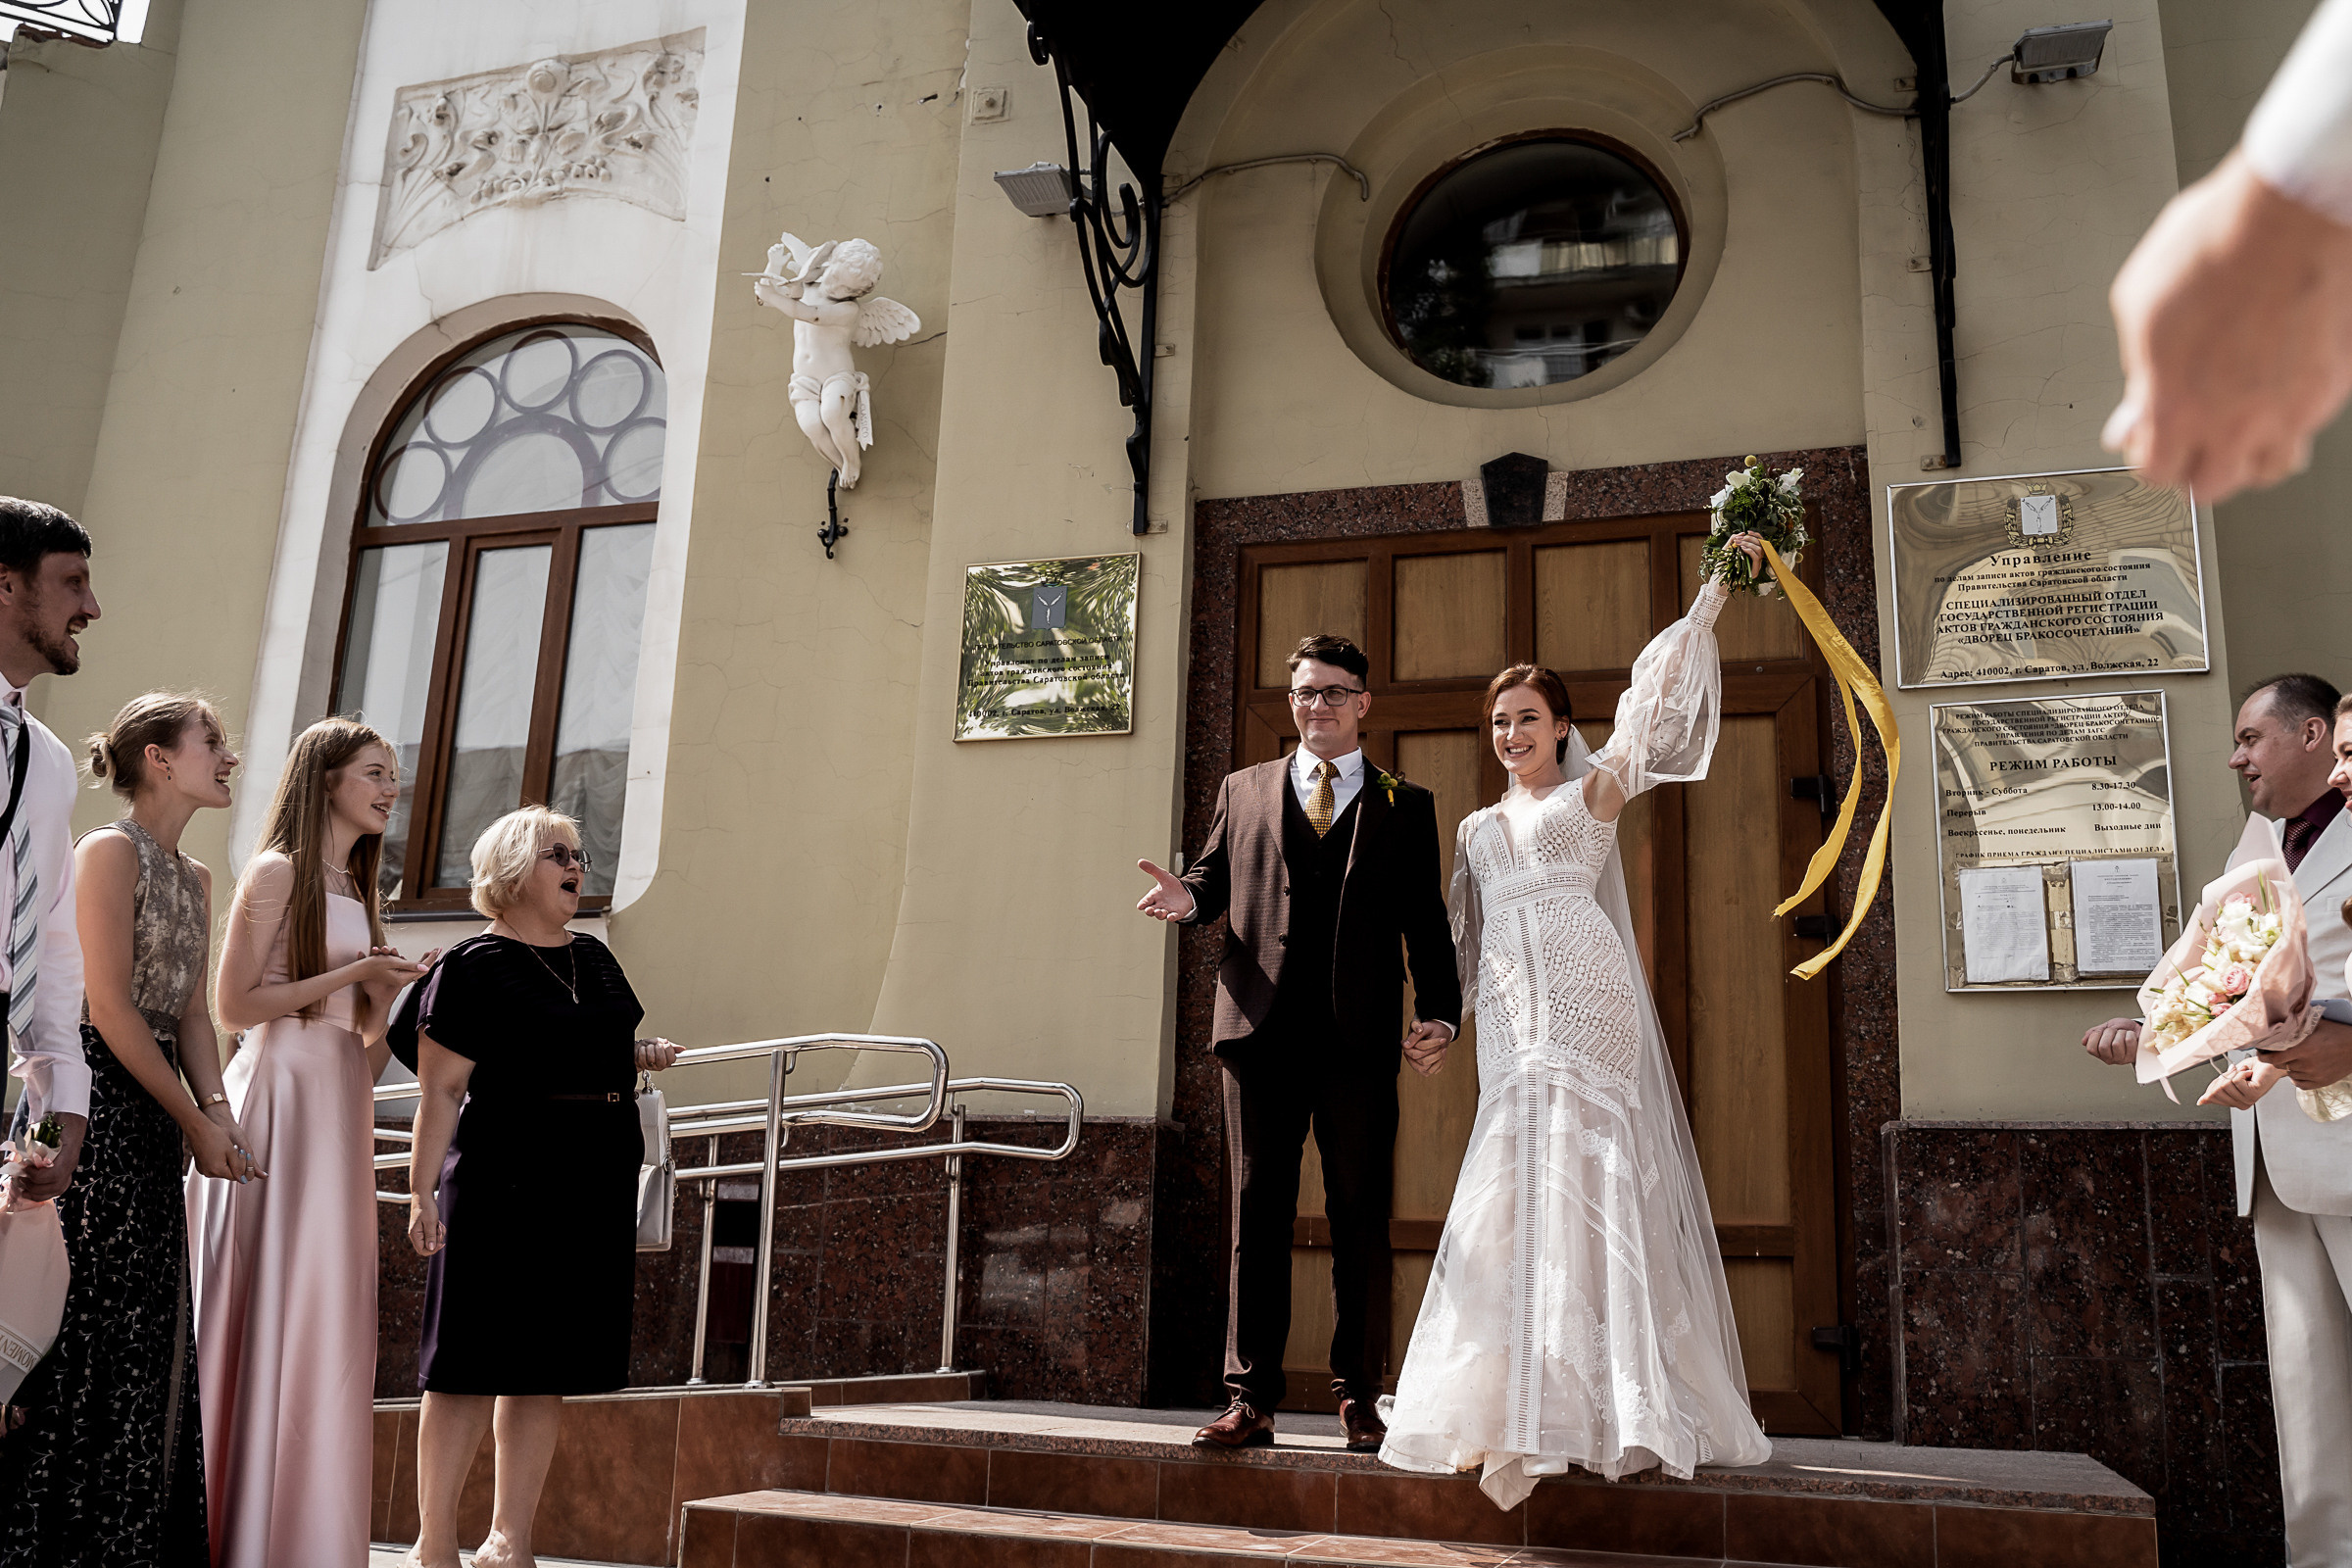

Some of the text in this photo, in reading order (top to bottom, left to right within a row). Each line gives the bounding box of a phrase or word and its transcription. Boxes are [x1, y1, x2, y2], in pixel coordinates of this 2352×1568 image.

[1989, 552, 2091, 567] Управление
[1947, 574, 1974, 583] делам
[2037, 566, 2101, 577] гражданского
[2103, 563, 2151, 571] состояния
[1958, 574, 2128, 593] Правительства Саратовской области
[1945, 589, 2147, 610] СПЕЦИАЛИЗИРОВАННЫЙ ОТДЕЛ
[1939, 601, 2158, 621] ГОСУДАРСТВЕННОЙ РЕГИСТРАЦИИ
[1936, 612, 2164, 634] АКТОВ ГРАЖДАНСКОГО СОСТОЯНИЯ
[1957, 623, 2140, 645] «ДВОРЕЦ БРАКОСОЧЕТАНИЙ»
[974, 635, 1123, 651] ПРАВИТЕЛЬСТВО САРАТОВСКОЙ ОБЛАСТИ
[985, 659, 1035, 667] Управление
[1006, 666, 1065, 677] гражданского
[1068, 663, 1112, 672] состояния
[1940, 670, 1974, 679] Адрес:
[1976, 667, 2013, 676] 410002,
[2025, 664, 2070, 674] Саратов,
[2090, 661, 2145, 670] Волжская,
[967, 671, 1125, 688] Правительства Саратовской области
[1010, 708, 1047, 717] Саратов,
[2015, 705, 2113, 717] СПЕЦИАЛИЗИРОВАННОГО
[2113, 703, 2144, 711] ОТДЕЛА
[1972, 715, 2045, 726] ГОСУДАРСТВЕННОЙ
[2046, 712, 2101, 722] РЕГИСТРАЦИИ
[1942, 725, 2002, 734] ГРАЖДАНСКОГО
[2002, 723, 2049, 732] СОСТОЯНИЯ
[1995, 730, 2045, 739] УПРАВЛЕНИЯ
[1974, 738, 2035, 748] ПРАВИТЕЛЬСТВА
[2036, 734, 2091, 744] САРАТОВСКОЙ
[1989, 756, 2117, 771] РЕЖИМ РАБОТЫ
[1945, 789, 1984, 798] Вторник
[1991, 786, 2028, 796] Суббота
[2091, 781, 2136, 791] 8.30-17.30
[1946, 809, 1986, 818] Перерыв
[2092, 802, 2141, 811] 13.00-14.00
[1947, 826, 2067, 838] Воскресенье, понедельник
[2094, 823, 2142, 832] Выходные
